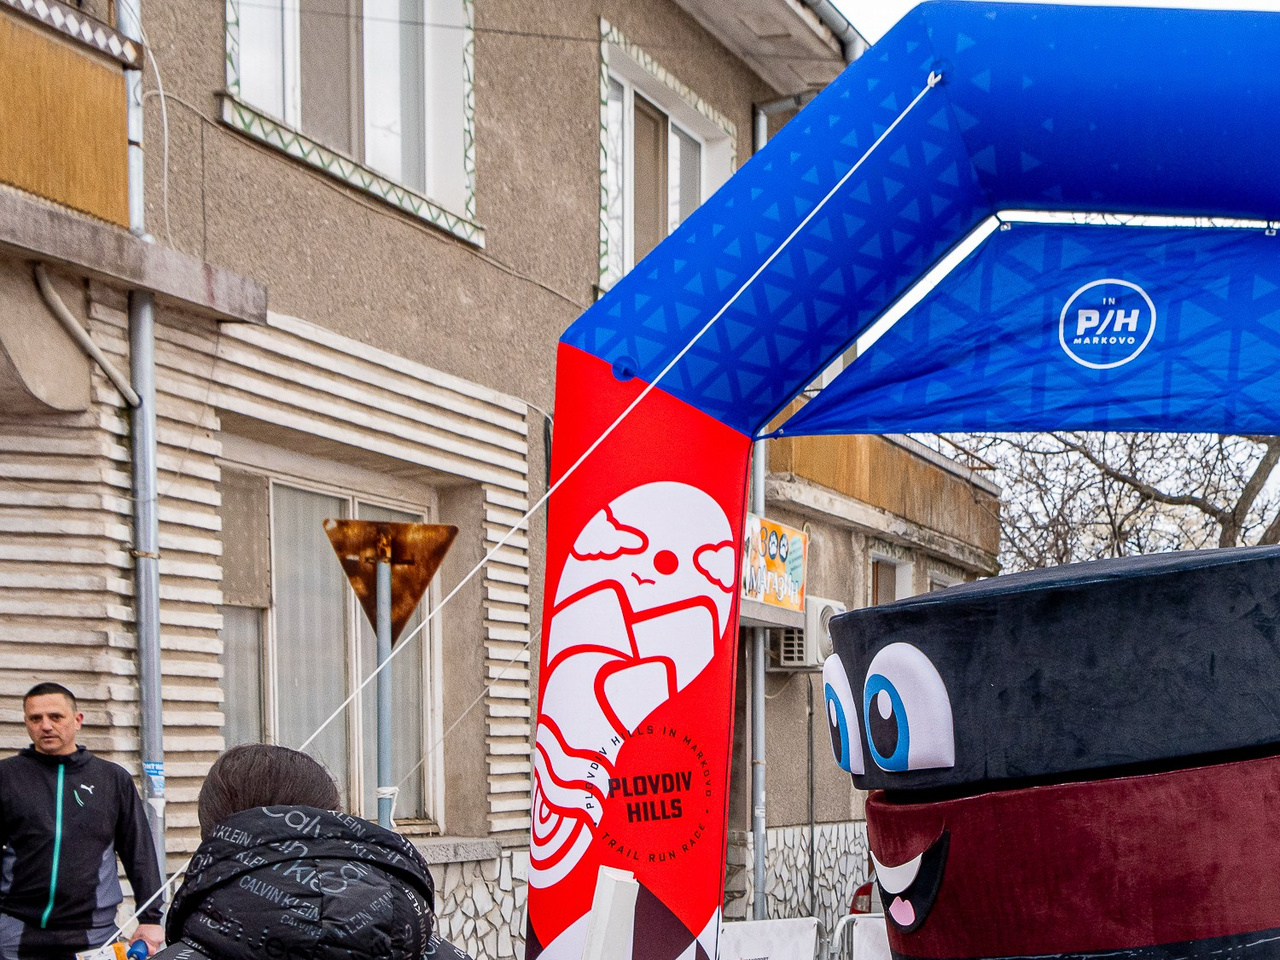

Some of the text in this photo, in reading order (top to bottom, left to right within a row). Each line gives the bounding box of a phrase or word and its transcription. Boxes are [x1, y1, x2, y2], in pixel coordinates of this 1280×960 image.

[1103, 297, 1116, 306] IN
[1077, 309, 1140, 335] P/H
[1073, 336, 1135, 344] MARKOVO
[585, 725, 711, 810] PLOVDIV HILLS IN MARKOVO
[608, 771, 692, 798] PLOVDIV
[626, 798, 682, 823] HILLS
[602, 822, 705, 862] TRAIL RUN RACE
[239, 875, 284, 904] CALVIN
